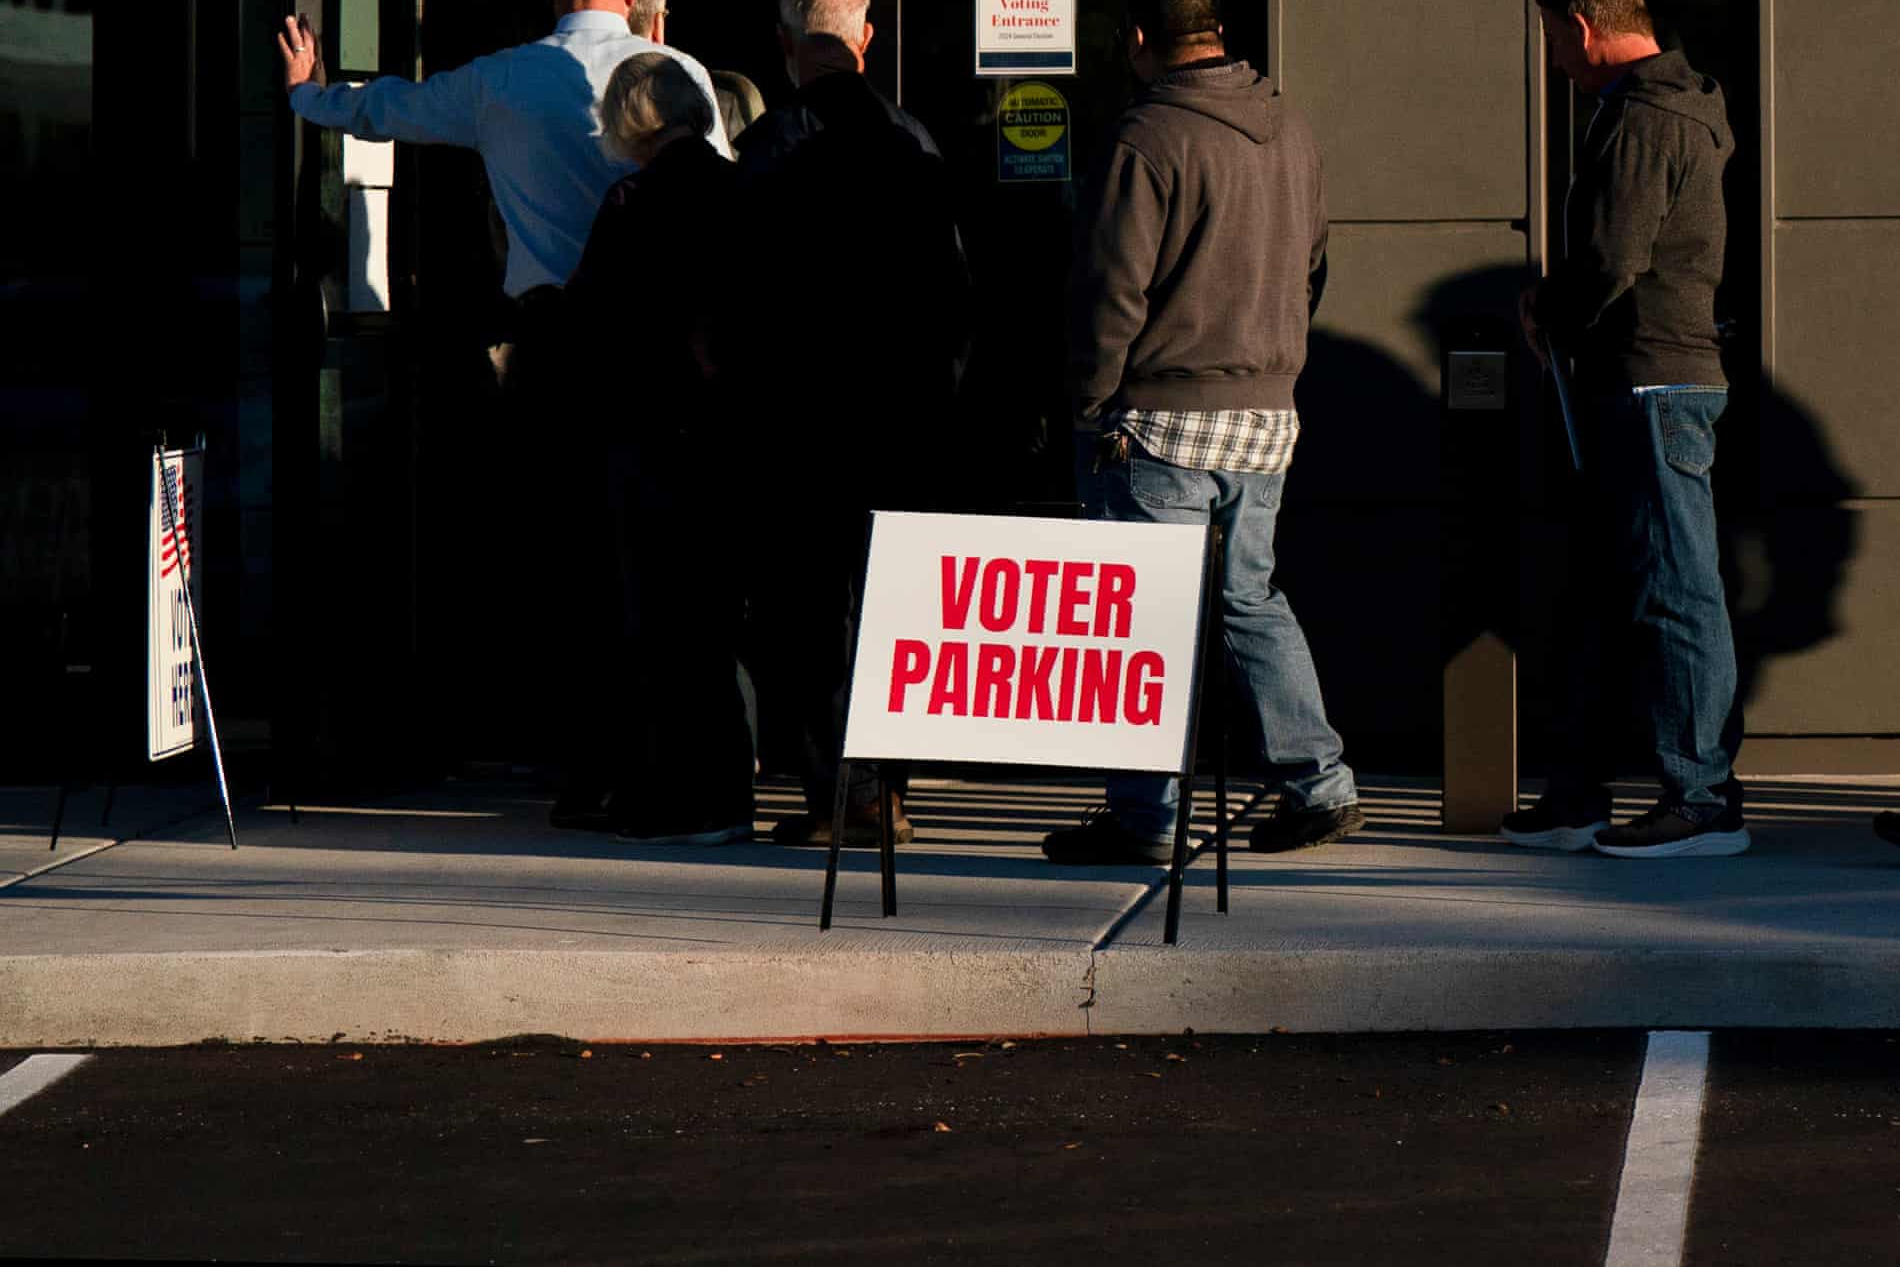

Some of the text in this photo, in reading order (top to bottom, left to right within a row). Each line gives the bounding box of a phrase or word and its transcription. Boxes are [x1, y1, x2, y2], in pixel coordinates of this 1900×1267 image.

[992, 14, 1060, 27] Entrance
[1005, 112, 1062, 124] CAUTION
[941, 556, 1136, 638] VOTER
[888, 639, 1165, 726] PARKING
